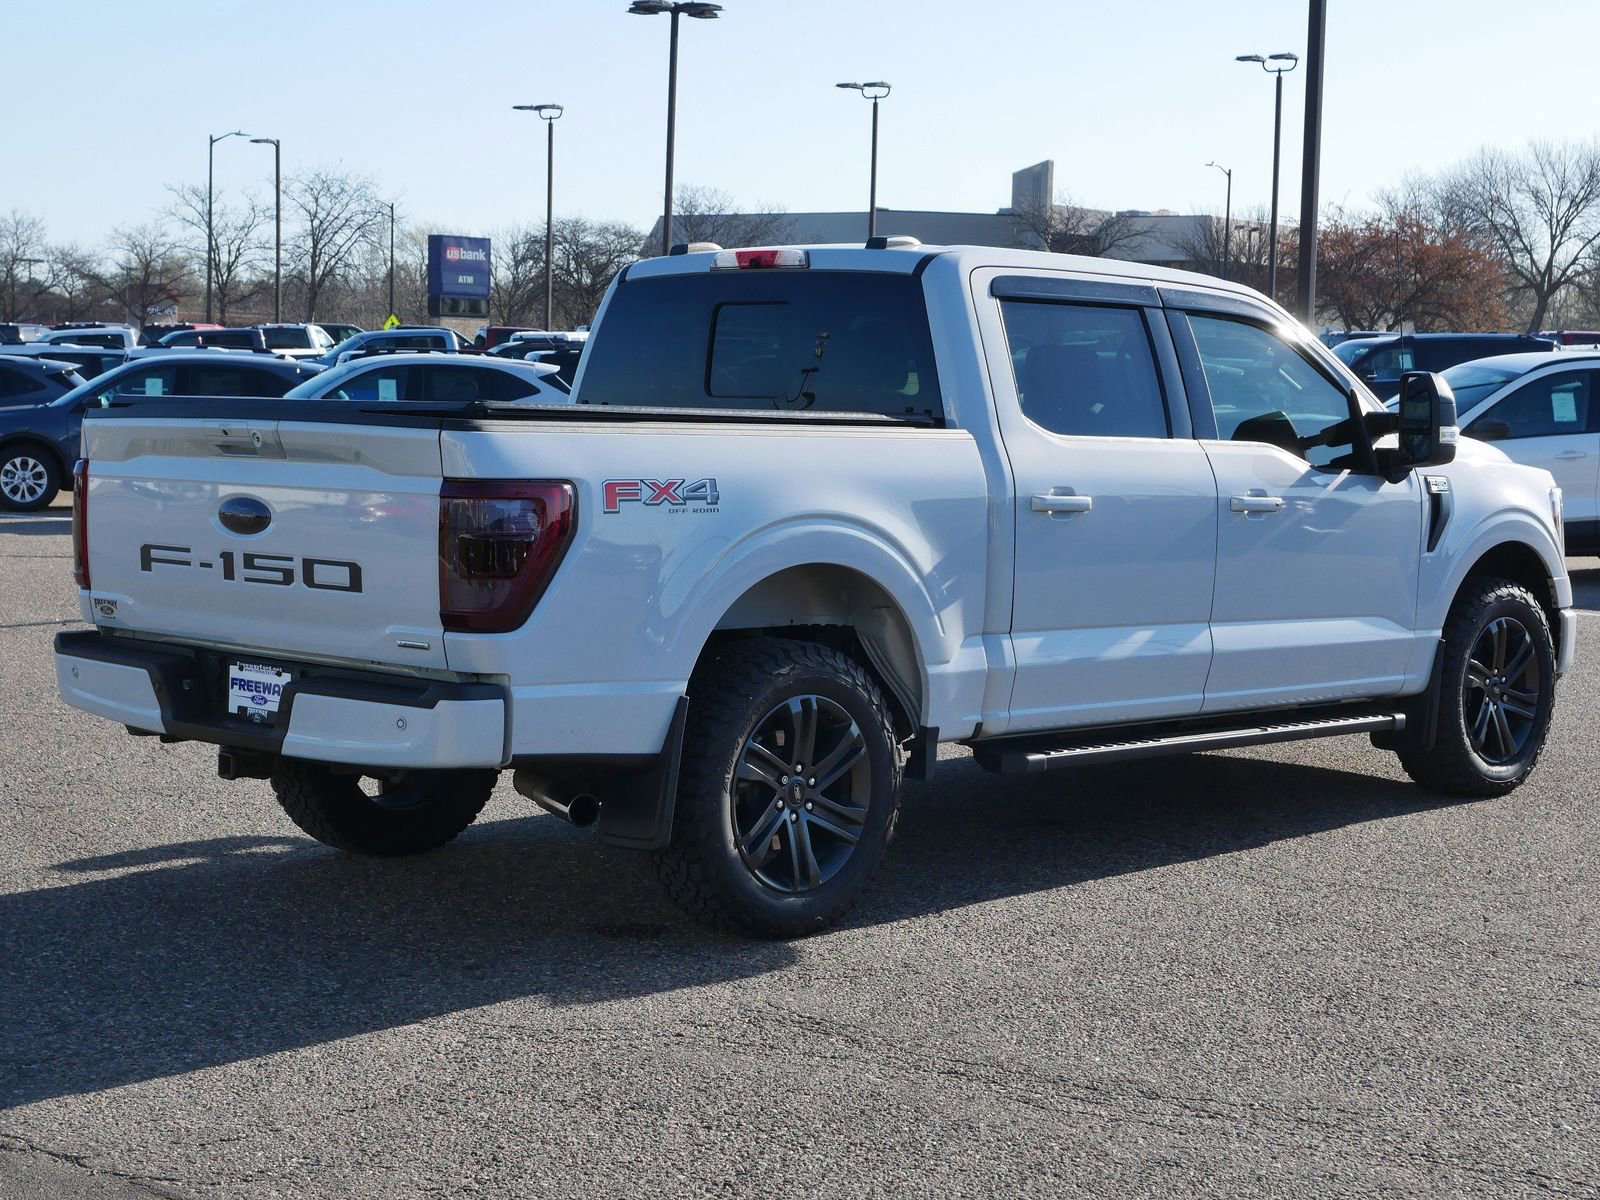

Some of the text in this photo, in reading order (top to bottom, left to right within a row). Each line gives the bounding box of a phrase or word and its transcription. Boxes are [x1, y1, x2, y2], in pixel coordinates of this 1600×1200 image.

[458, 275, 474, 284] ATM
[602, 478, 720, 514] FX4
[140, 543, 363, 593] F-150
